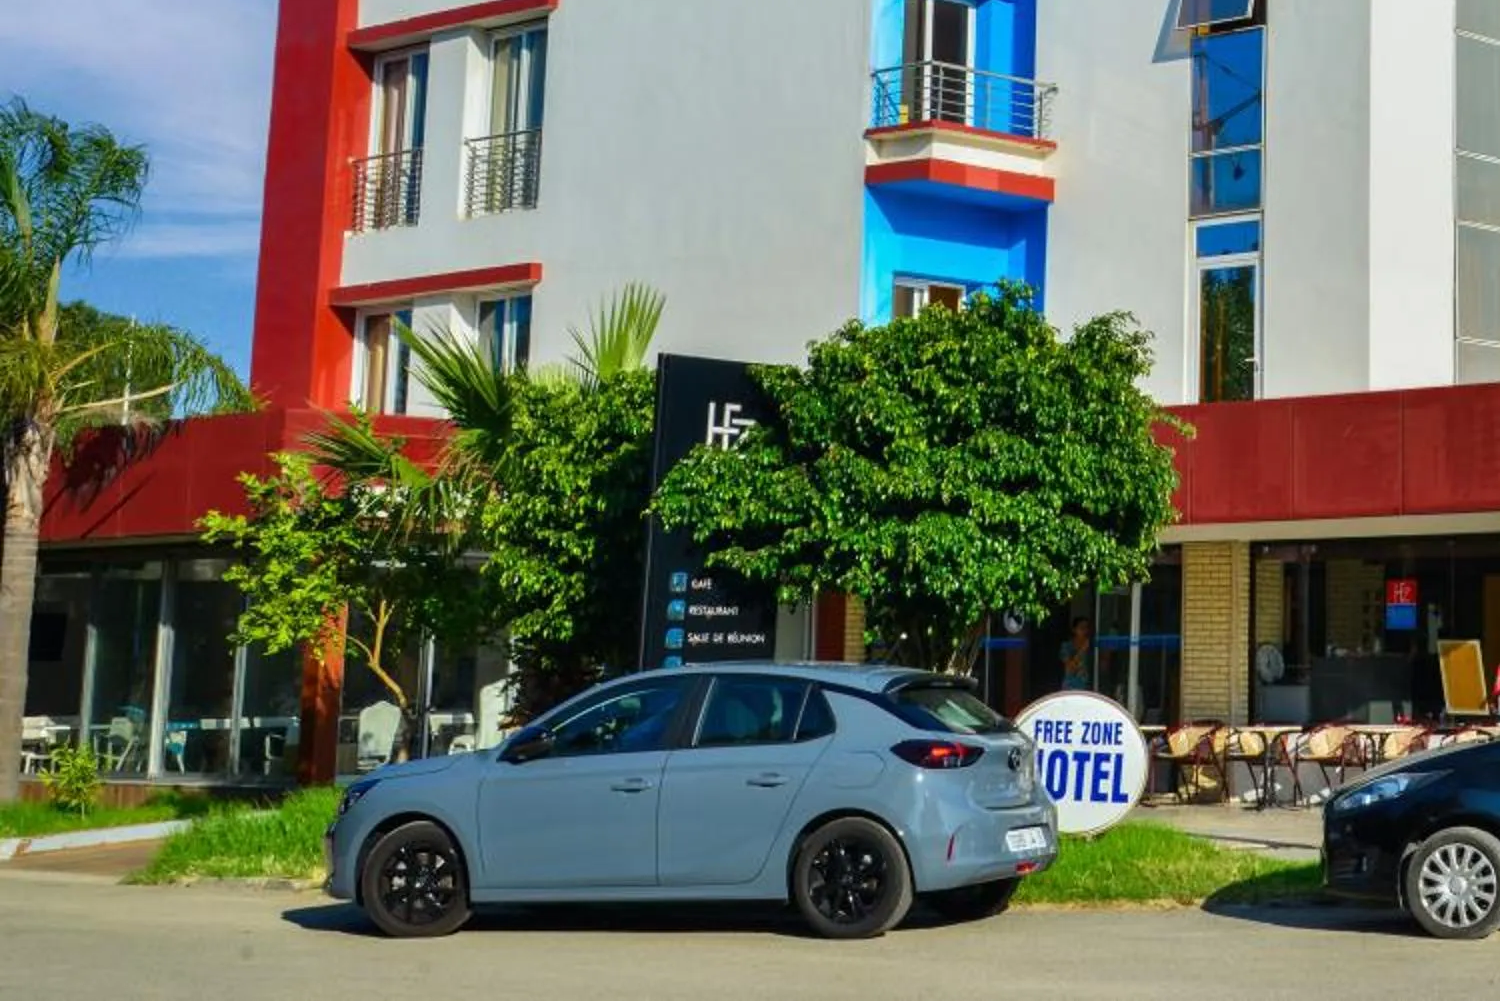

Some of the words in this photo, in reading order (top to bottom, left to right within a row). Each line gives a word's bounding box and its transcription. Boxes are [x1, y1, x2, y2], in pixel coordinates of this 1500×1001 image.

[688, 605, 739, 617] RESTAURANT
[713, 632, 724, 644] DE
[727, 631, 765, 644] RÉUNION
[1034, 719, 1073, 744] FREE
[1081, 721, 1123, 746] ZONE
